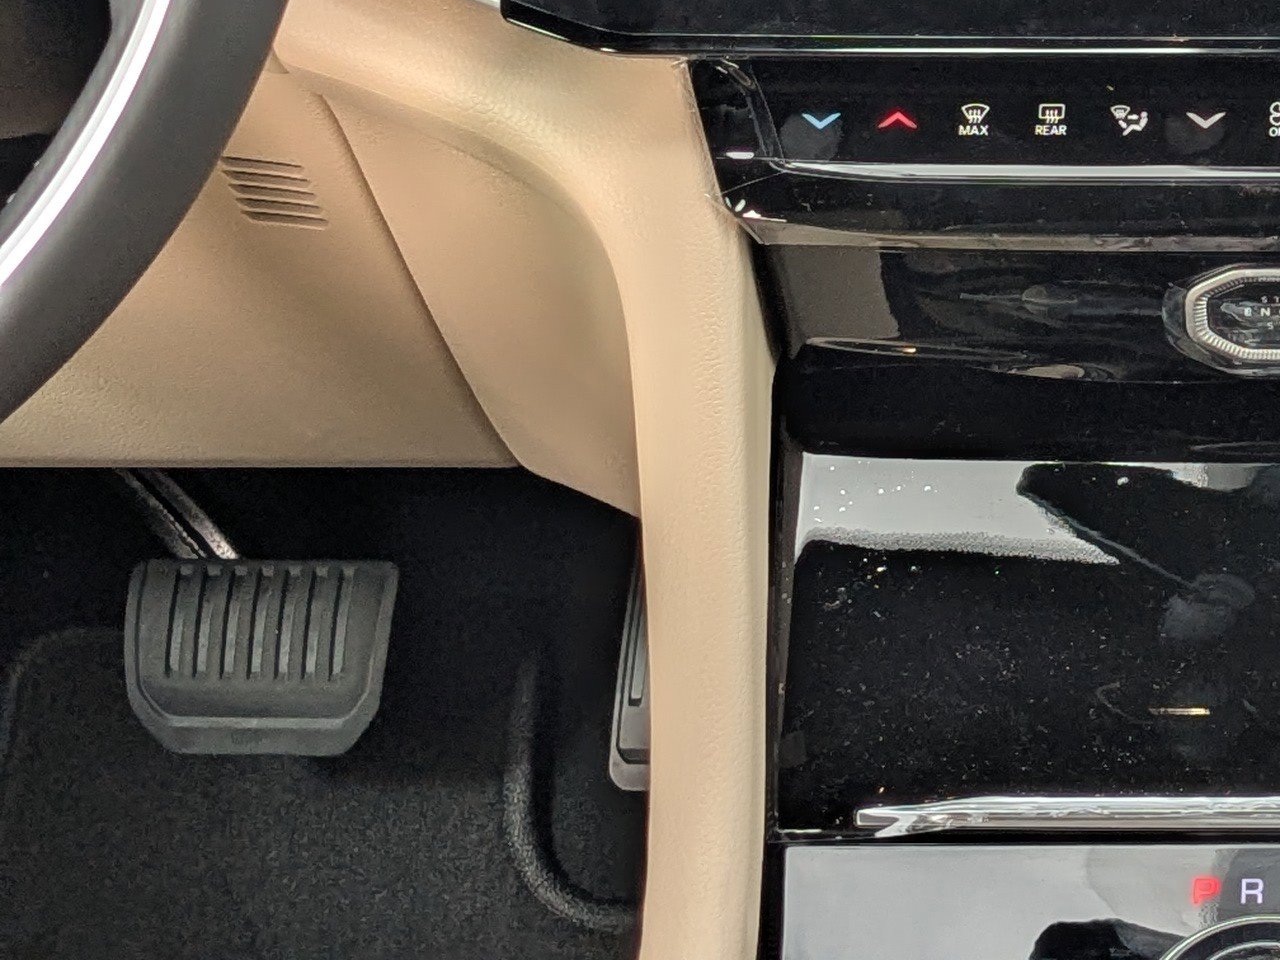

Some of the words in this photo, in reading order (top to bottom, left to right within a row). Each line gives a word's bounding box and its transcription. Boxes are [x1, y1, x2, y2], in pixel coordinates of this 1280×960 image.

[958, 125, 990, 137] MAX
[1035, 125, 1067, 137] REAR
[1192, 877, 1221, 904] P
[1240, 877, 1264, 904] R
